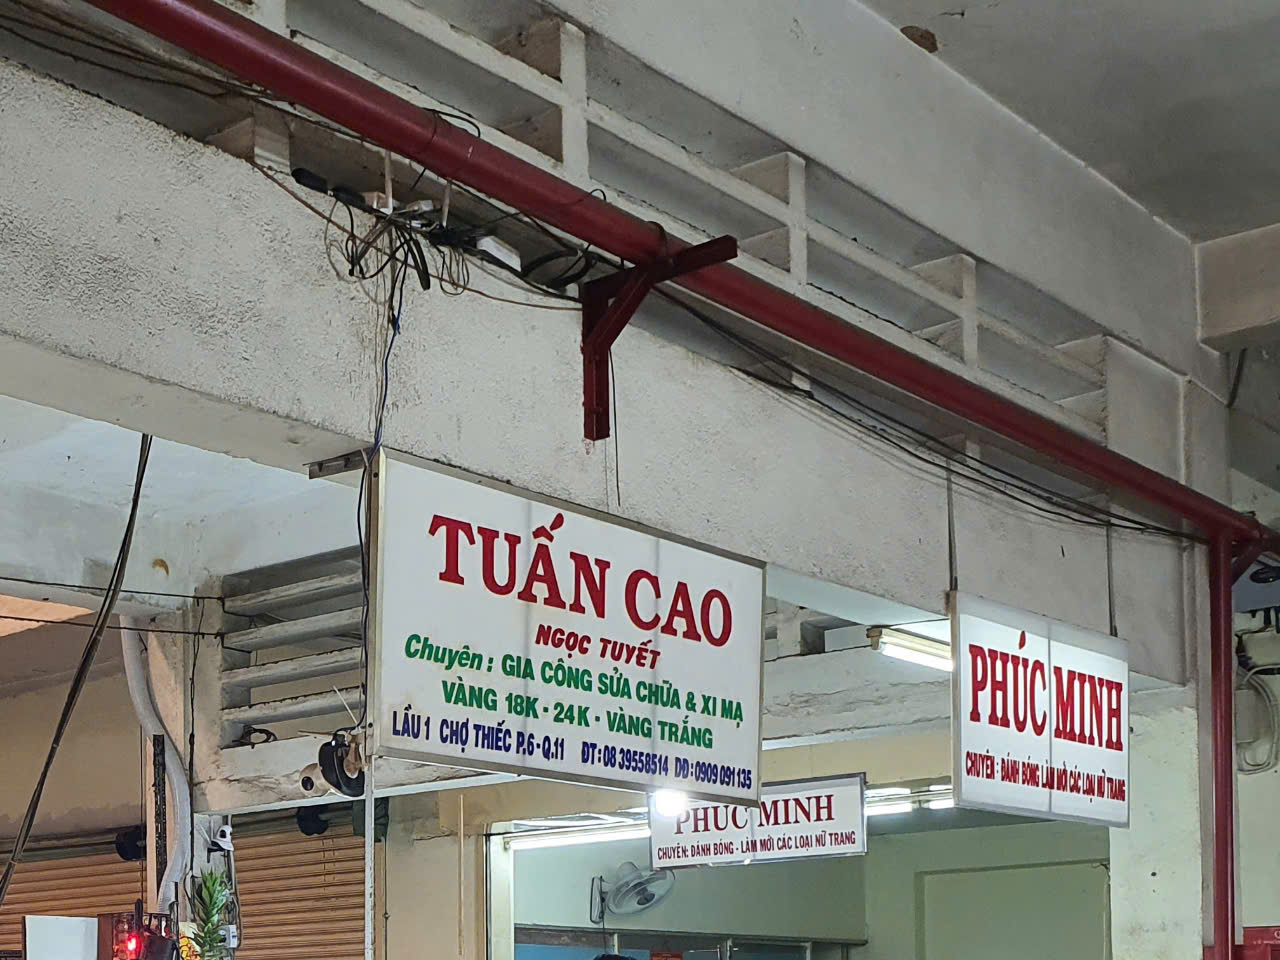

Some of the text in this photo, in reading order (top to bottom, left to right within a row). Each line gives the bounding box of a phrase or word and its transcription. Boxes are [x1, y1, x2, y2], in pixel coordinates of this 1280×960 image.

[428, 512, 733, 647] TUẤN CAO
[535, 624, 661, 670] NGỌC TUYẾT
[441, 676, 498, 712] VÀNG
[505, 692, 540, 719] 18K
[606, 706, 652, 738] VÀNG
[657, 714, 713, 749] TRẮNG
[501, 654, 535, 681] GIA
[541, 656, 593, 693] CÔNG
[597, 667, 632, 699] SỬA
[635, 680, 681, 710] CHỮA
[685, 691, 697, 713] &
[701, 694, 717, 717] XI
[721, 698, 744, 728] MẠ
[968, 630, 1124, 752] PHÚC MINH
[392, 704, 421, 739] LẦU
[424, 716, 431, 741] 1
[439, 717, 469, 753] CHỢ
[473, 720, 512, 753] THIẾC
[1001, 752, 1020, 785] ĐÁNH
[1021, 755, 1040, 788] BÓNG
[1069, 765, 1082, 795] CÁC
[1106, 776, 1126, 802] TRANG
[757, 794, 835, 827] MINH
[691, 842, 711, 858] ĐÁNH
[713, 838, 734, 856] BÓNG
[741, 836, 758, 854] LÀM
[760, 834, 774, 852] MỚI
[777, 832, 793, 850] CÁC
[794, 834, 813, 852] LOẠI
[815, 830, 827, 848] NỮ
[828, 831, 856, 846] TRANG
